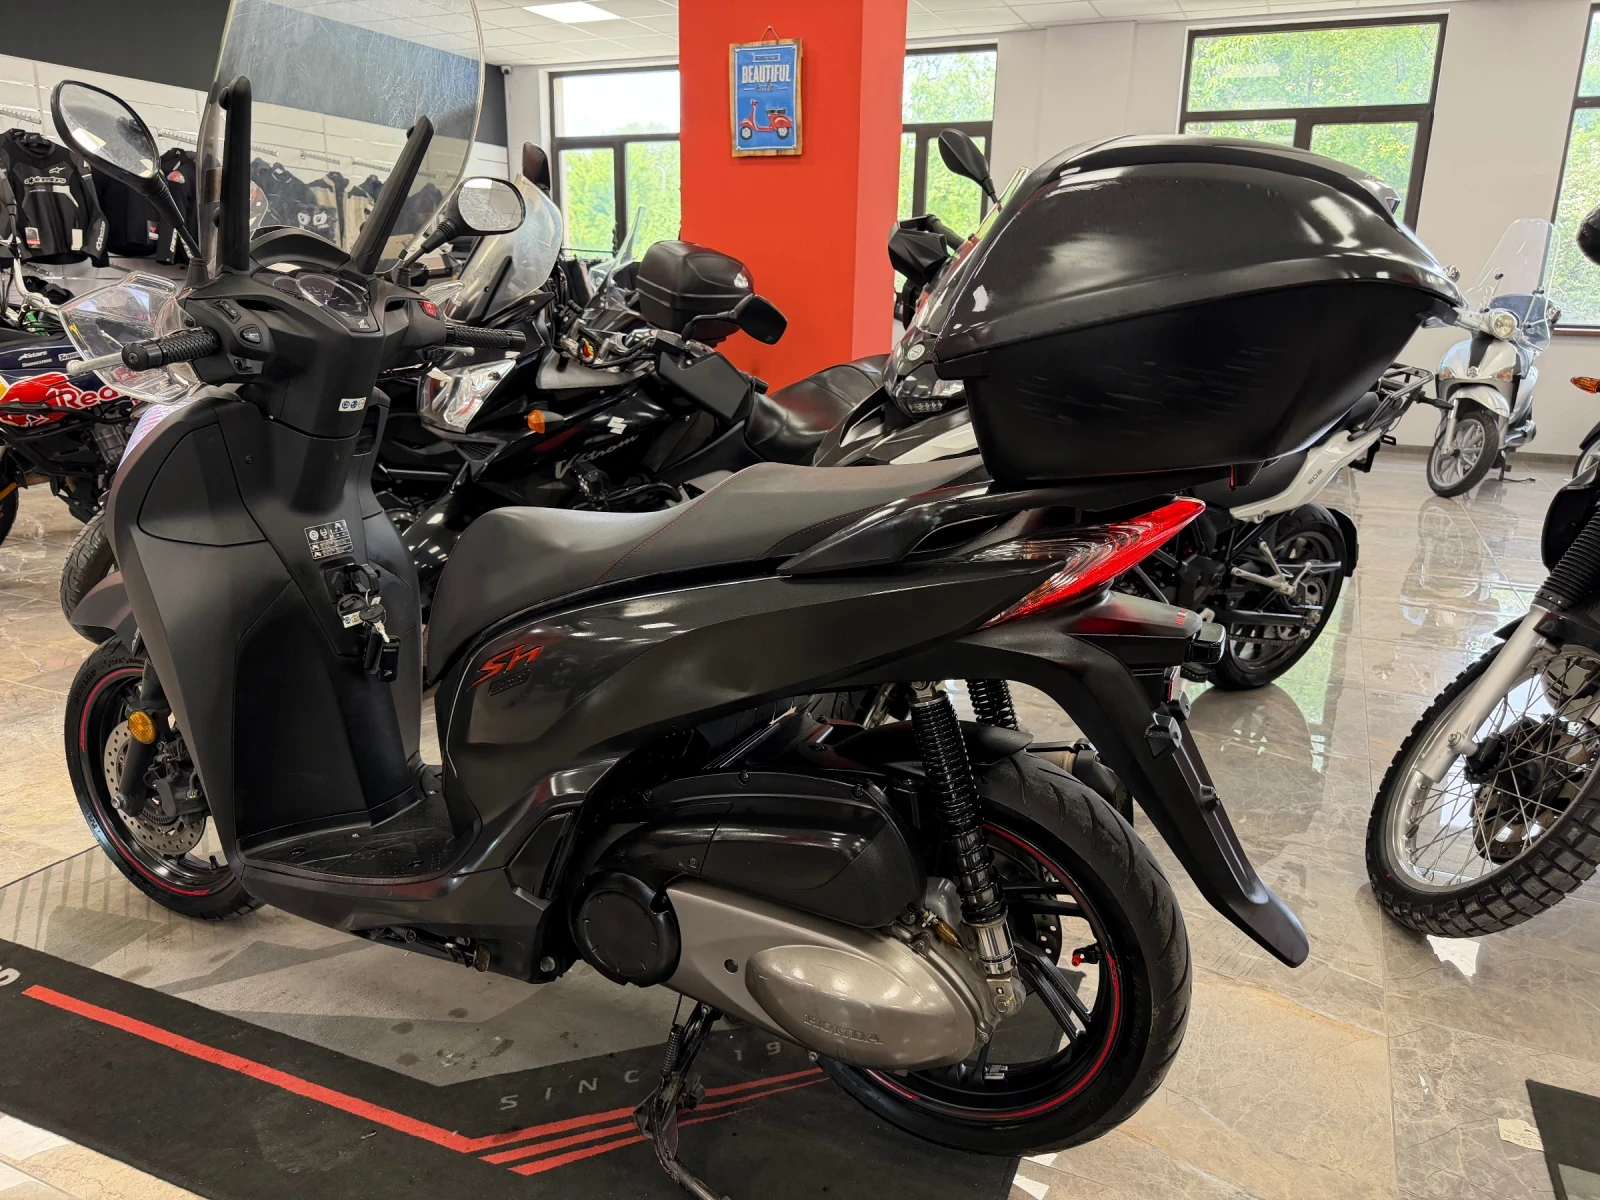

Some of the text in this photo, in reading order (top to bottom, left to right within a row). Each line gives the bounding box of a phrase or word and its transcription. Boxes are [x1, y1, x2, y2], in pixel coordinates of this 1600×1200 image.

[741, 64, 791, 84] BEAUTIFUL
[804, 1014, 884, 1046] HONDA
[499, 1041, 782, 1111] SINC 19
